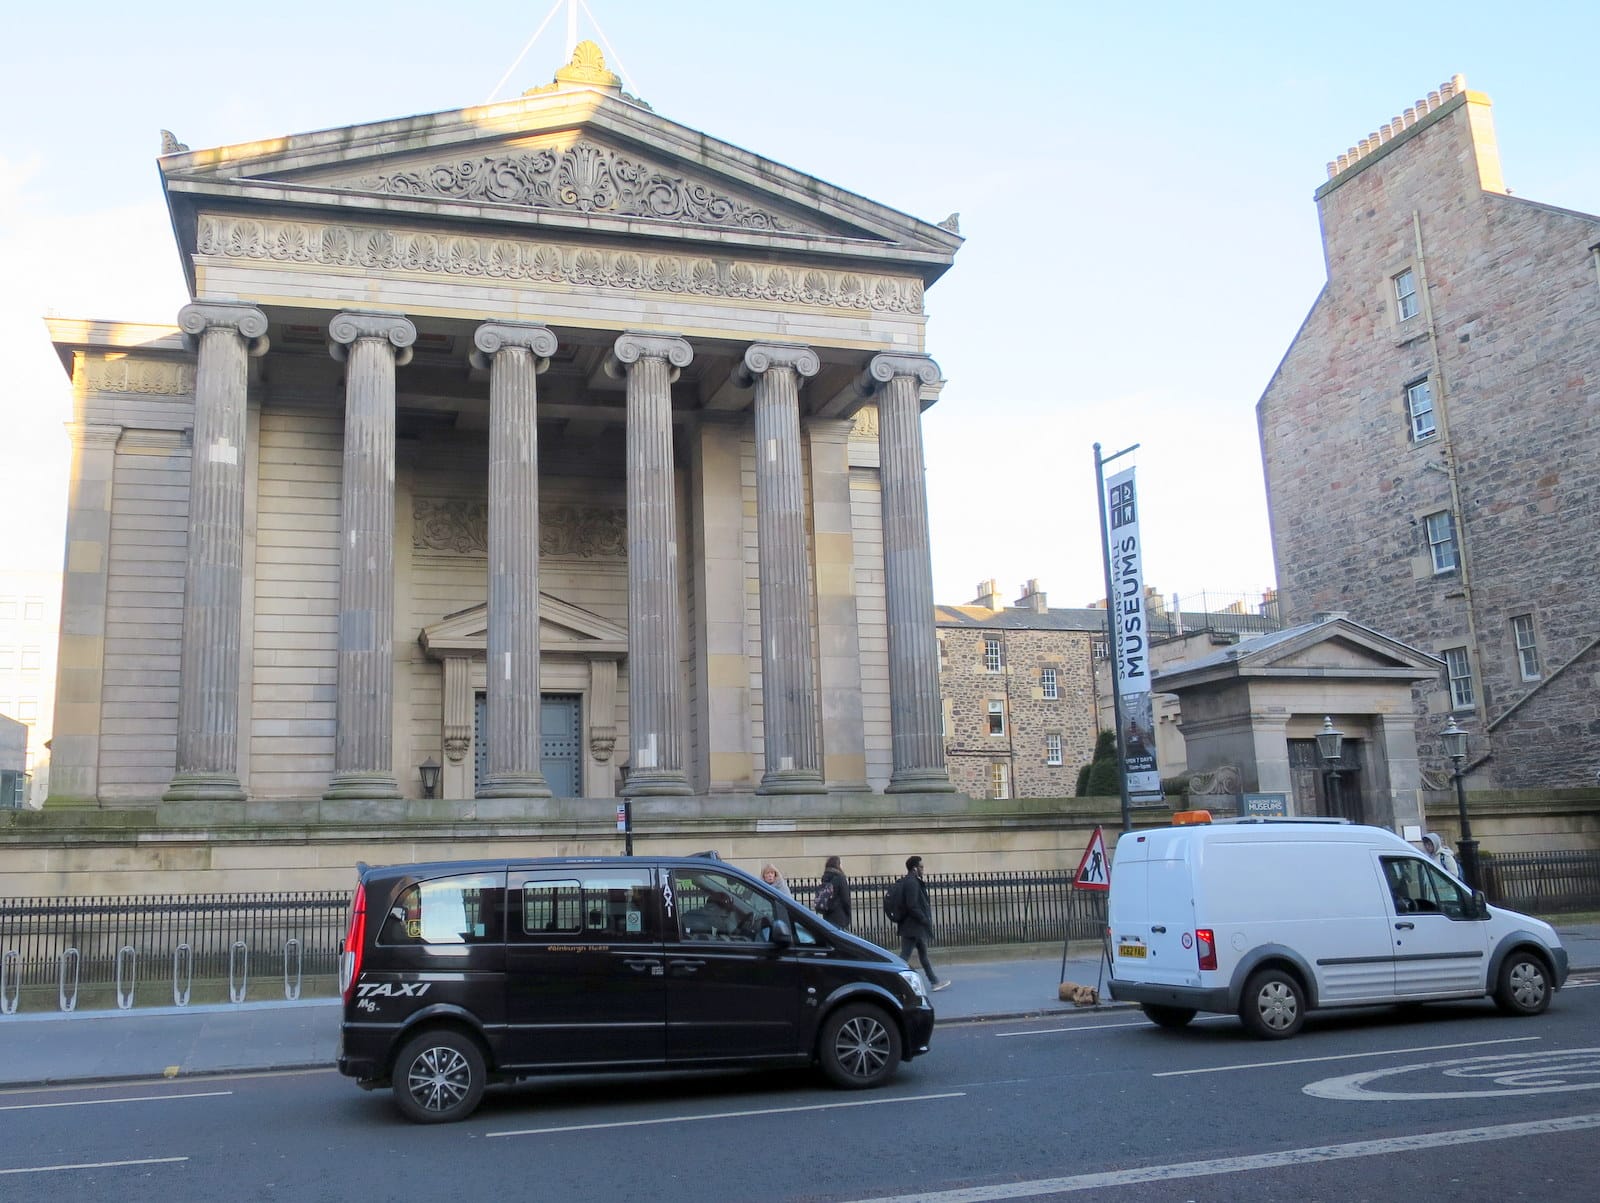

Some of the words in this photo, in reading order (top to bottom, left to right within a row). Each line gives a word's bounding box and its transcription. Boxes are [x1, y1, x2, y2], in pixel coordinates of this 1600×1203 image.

[1113, 540, 1121, 582] HALL
[1122, 535, 1145, 679] MUSEUMS
[1248, 803, 1283, 811] MUSEUMS
[662, 874, 673, 918] TAXI
[357, 983, 433, 997] TAXI
